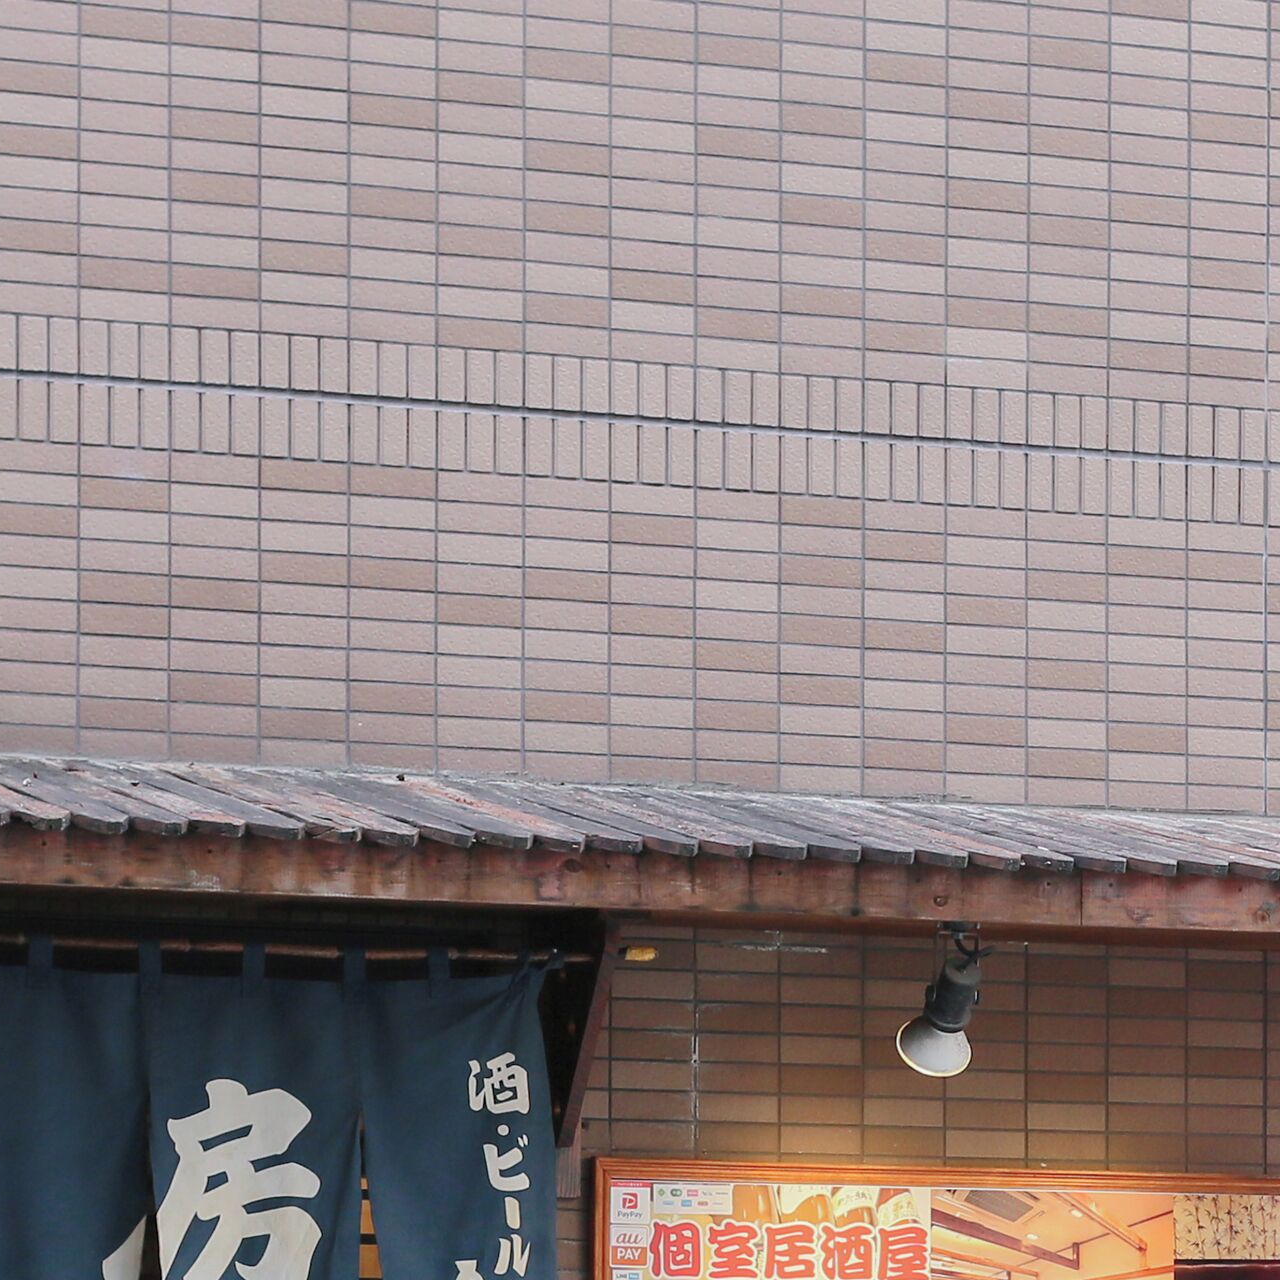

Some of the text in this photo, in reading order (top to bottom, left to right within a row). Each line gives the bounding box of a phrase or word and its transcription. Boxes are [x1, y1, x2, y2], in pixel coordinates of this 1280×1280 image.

[467, 1051, 531, 1278] 酒・ビール
[616, 1232, 642, 1245] au
[617, 1248, 642, 1260] PAY
[649, 1221, 930, 1280] 個室居酒屋
